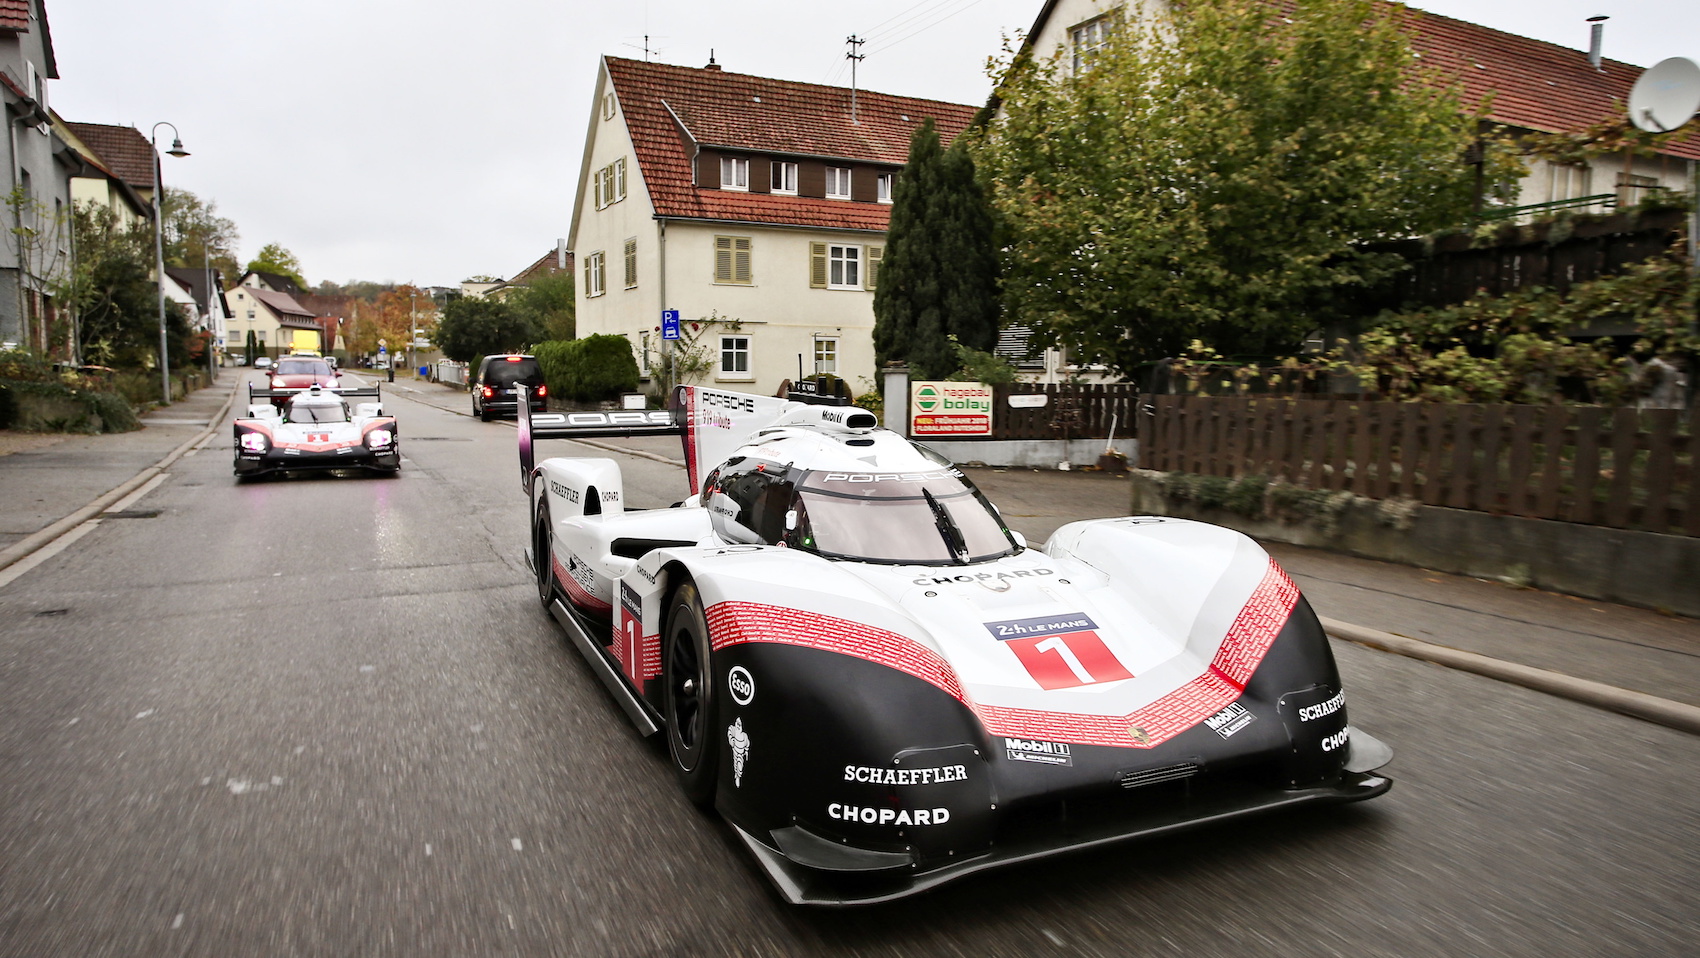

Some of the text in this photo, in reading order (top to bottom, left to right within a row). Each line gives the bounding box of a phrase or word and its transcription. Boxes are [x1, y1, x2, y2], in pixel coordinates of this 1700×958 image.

[665, 312, 672, 324] P
[943, 387, 990, 399] hagebau
[702, 392, 754, 413] PORSCHE
[944, 398, 990, 412] bolay
[702, 409, 713, 425] 919
[821, 410, 837, 422] Mobil
[823, 468, 965, 483] PORSCHE
[550, 480, 579, 505] SCHAEFFLER
[602, 491, 618, 502] CHOPARD
[637, 564, 656, 585] CHOPARD
[912, 568, 1054, 586] CHOPARD
[996, 619, 1089, 636] 24h LE MANS
[627, 620, 636, 680] 1
[1034, 636, 1097, 684] 1
[732, 673, 750, 696] Esso
[1203, 707, 1238, 730] Mobil
[1005, 738, 1053, 753] Mobil
[1026, 754, 1067, 763] MICHELIN
[844, 765, 968, 785] SCHAEFFLER
[828, 803, 950, 826] CHOPARD
